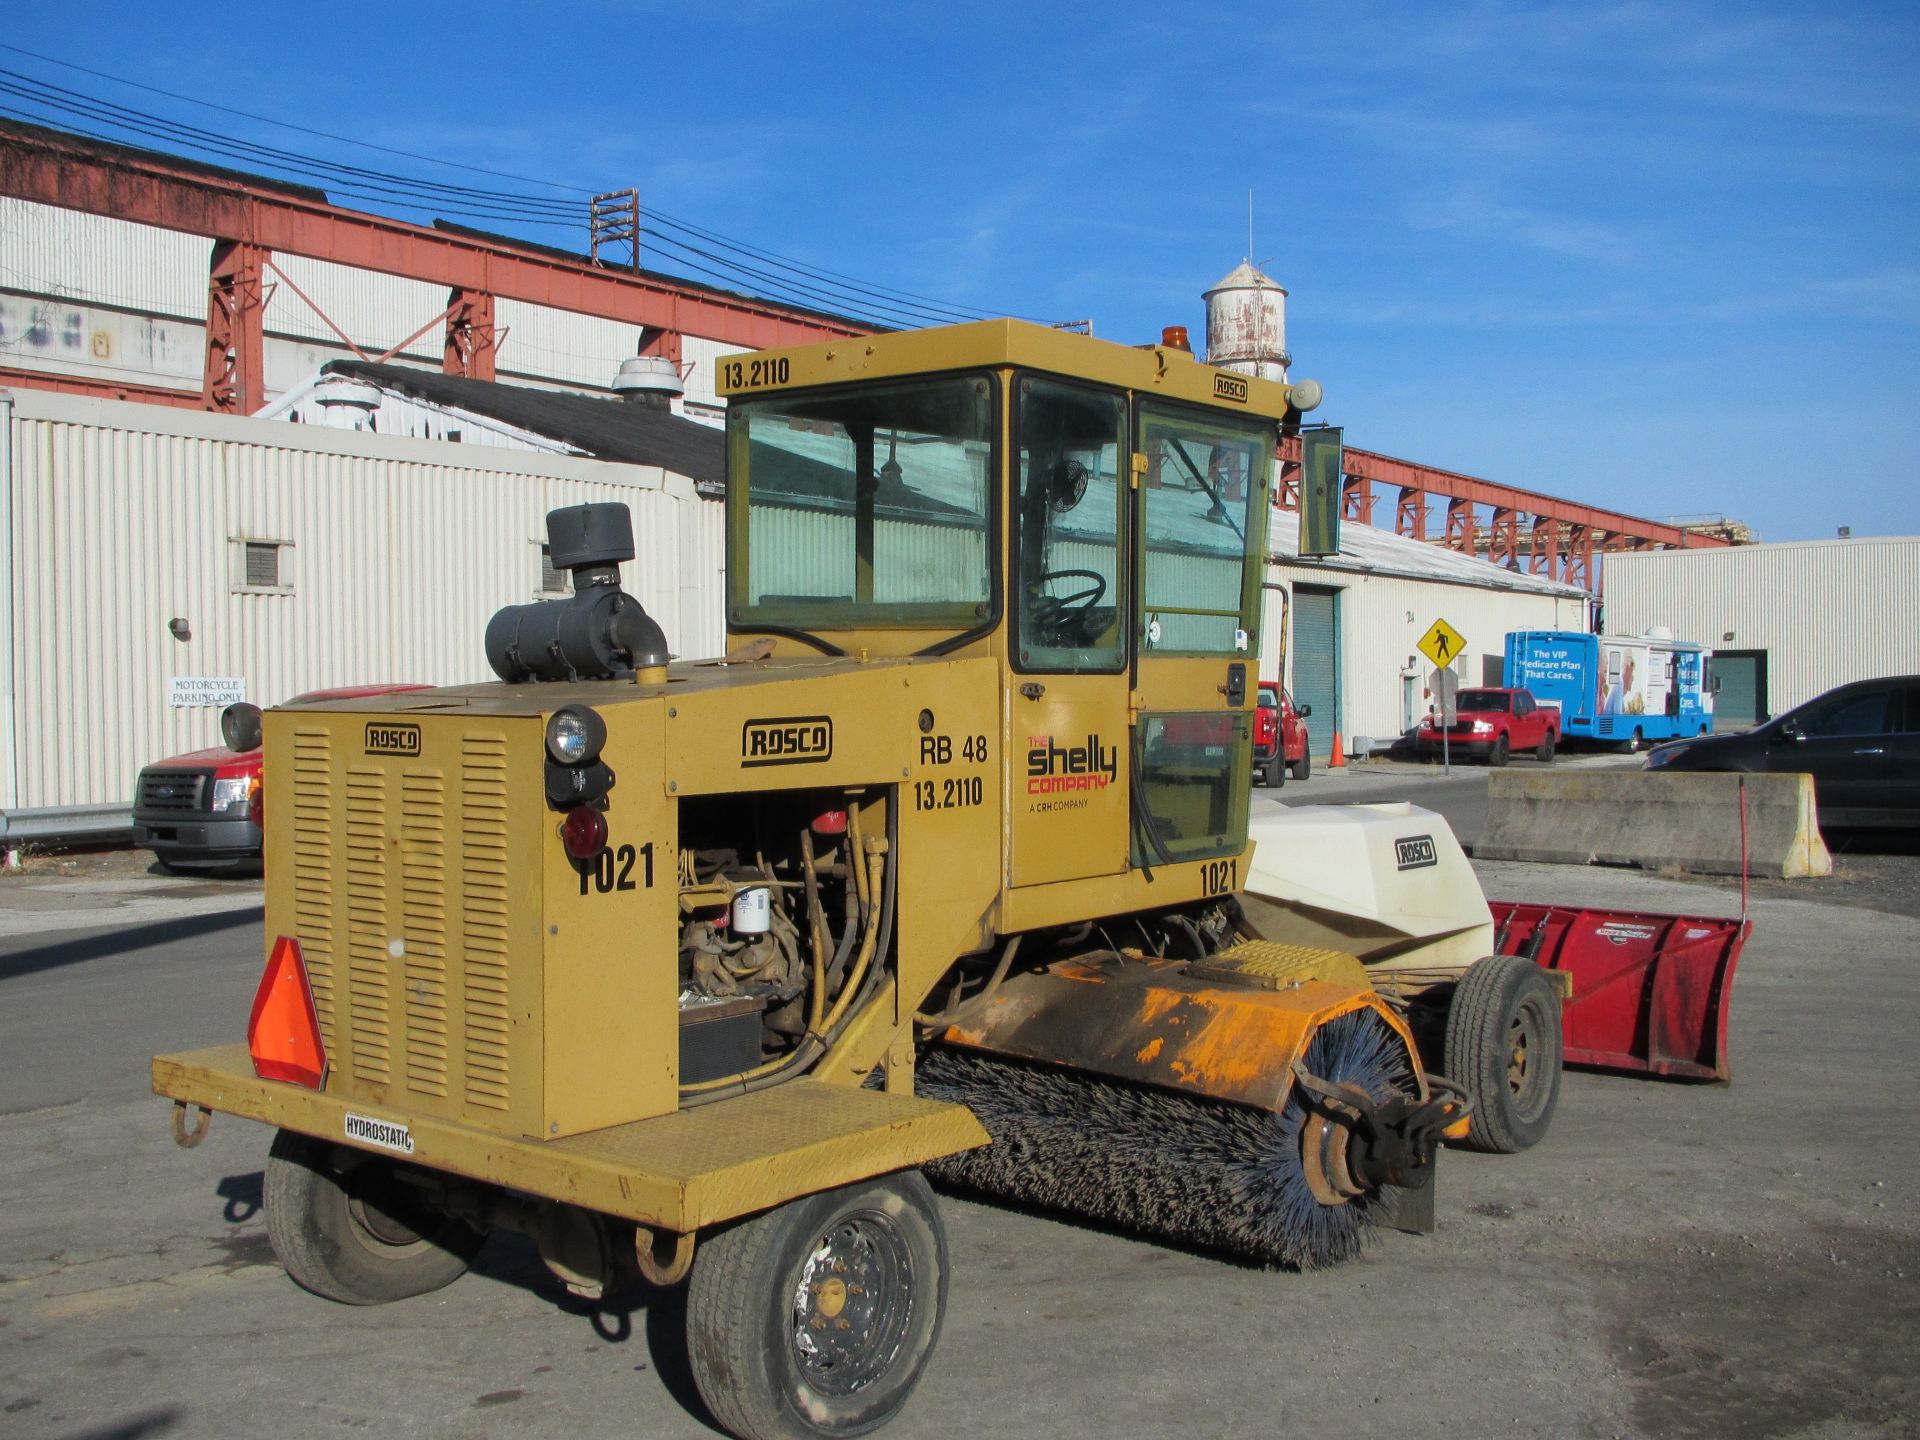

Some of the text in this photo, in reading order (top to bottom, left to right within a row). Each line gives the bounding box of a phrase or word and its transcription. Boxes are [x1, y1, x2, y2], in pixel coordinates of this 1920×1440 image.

[724, 357, 790, 389] 13.2110
[1217, 379, 1246, 398] ROSCO
[1533, 650, 1568, 659] The VIP
[1525, 670, 1575, 680] That Cares.
[1561, 661, 1581, 670] Plan
[175, 680, 239, 690] MOTORCYCLE
[172, 693, 242, 703] PARKING ONLY
[369, 729, 417, 749] ROSCO
[750, 726, 827, 756] ROSCO
[1027, 736, 1048, 748] THE
[920, 735, 988, 766] RB 48
[1027, 734, 1117, 783] shelly
[914, 776, 983, 811] 13.2110
[1027, 774, 1109, 795] COMPANY
[1029, 799, 1089, 813] A CRH COMPANY
[1399, 841, 1433, 864] ROSCO
[1200, 859, 1237, 897] 1021
[346, 1116, 412, 1150] HYDROSTATIC
